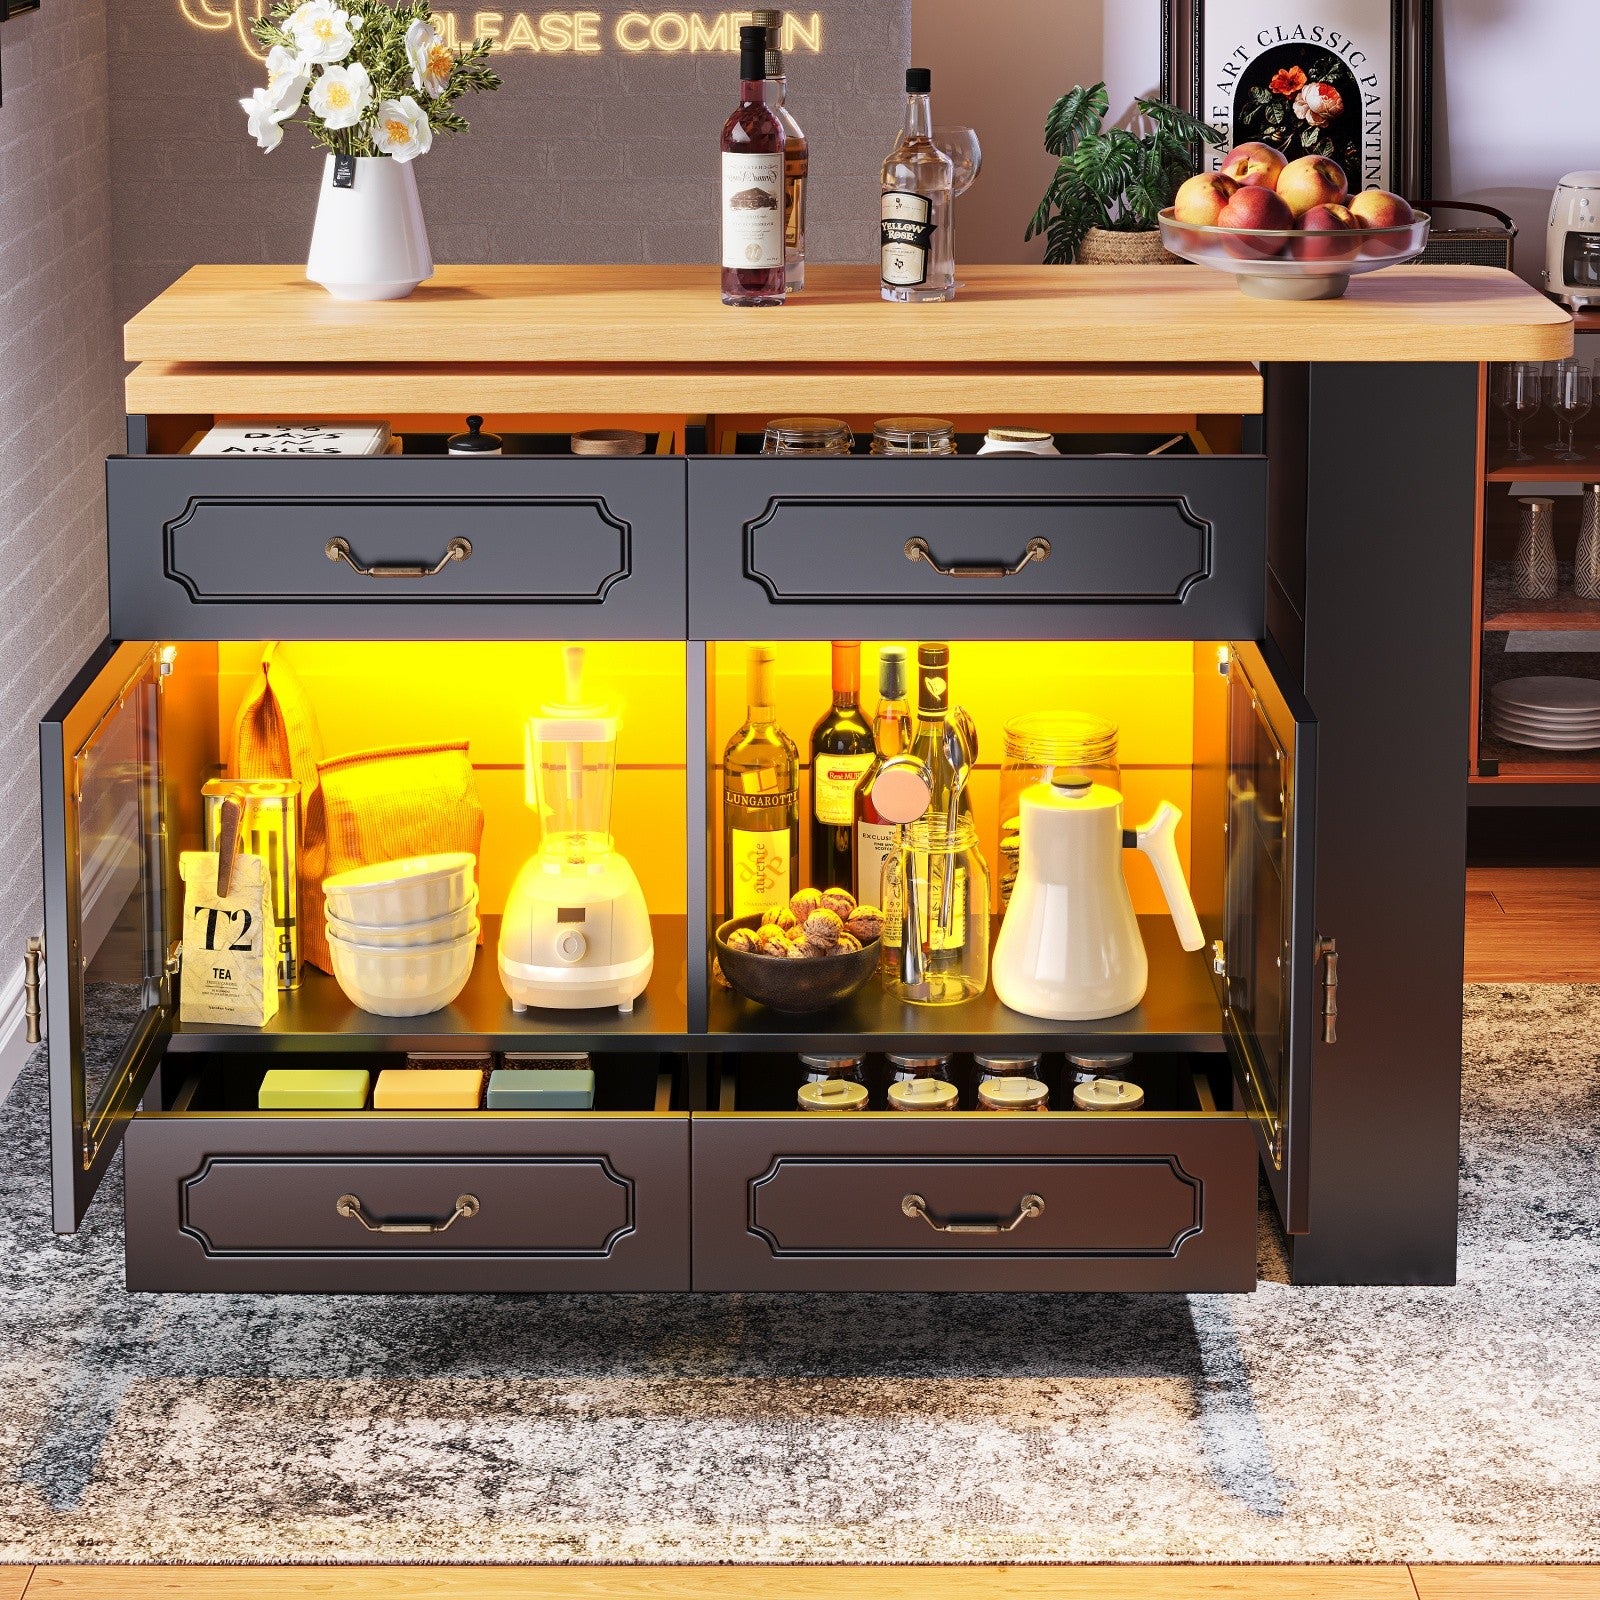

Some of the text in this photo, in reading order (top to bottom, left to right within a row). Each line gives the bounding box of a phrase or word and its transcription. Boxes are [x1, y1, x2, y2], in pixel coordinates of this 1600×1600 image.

[1216, 45, 1251, 97] ART
[1256, 24, 1368, 69] CLASSIC
[1360, 73, 1382, 191] PAINTIN
[881, 221, 927, 234] YELLOW
[887, 229, 915, 241] ROSE
[244, 432, 343, 440] DAYS
[221, 446, 342, 454] ARLES
[726, 790, 798, 807] LUNGAROTTI
[755, 843, 766, 894] aurente
[193, 905, 253, 953] T2
[212, 967, 232, 981] TEA
